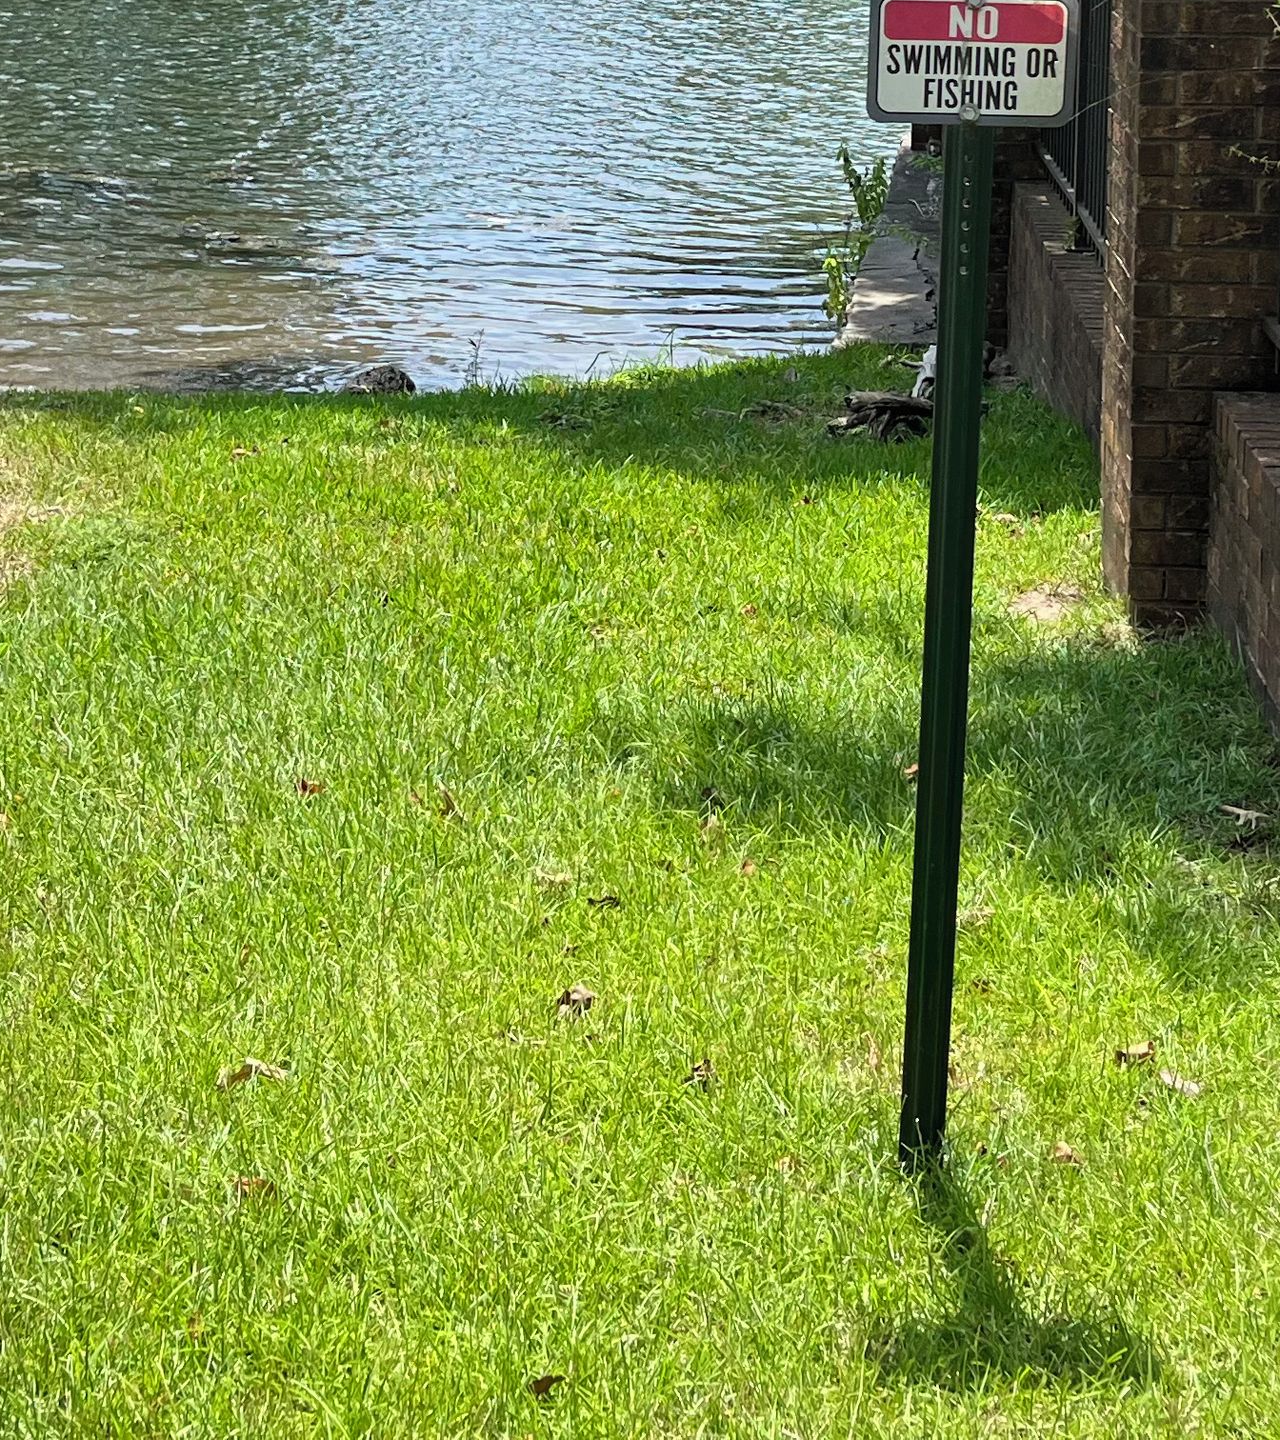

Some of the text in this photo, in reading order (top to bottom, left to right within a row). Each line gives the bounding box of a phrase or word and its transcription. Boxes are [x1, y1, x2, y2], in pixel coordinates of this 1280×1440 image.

[948, 4, 999, 40] NO
[886, 44, 1059, 78] SWIMMING OR
[923, 78, 1018, 111] FISHING
